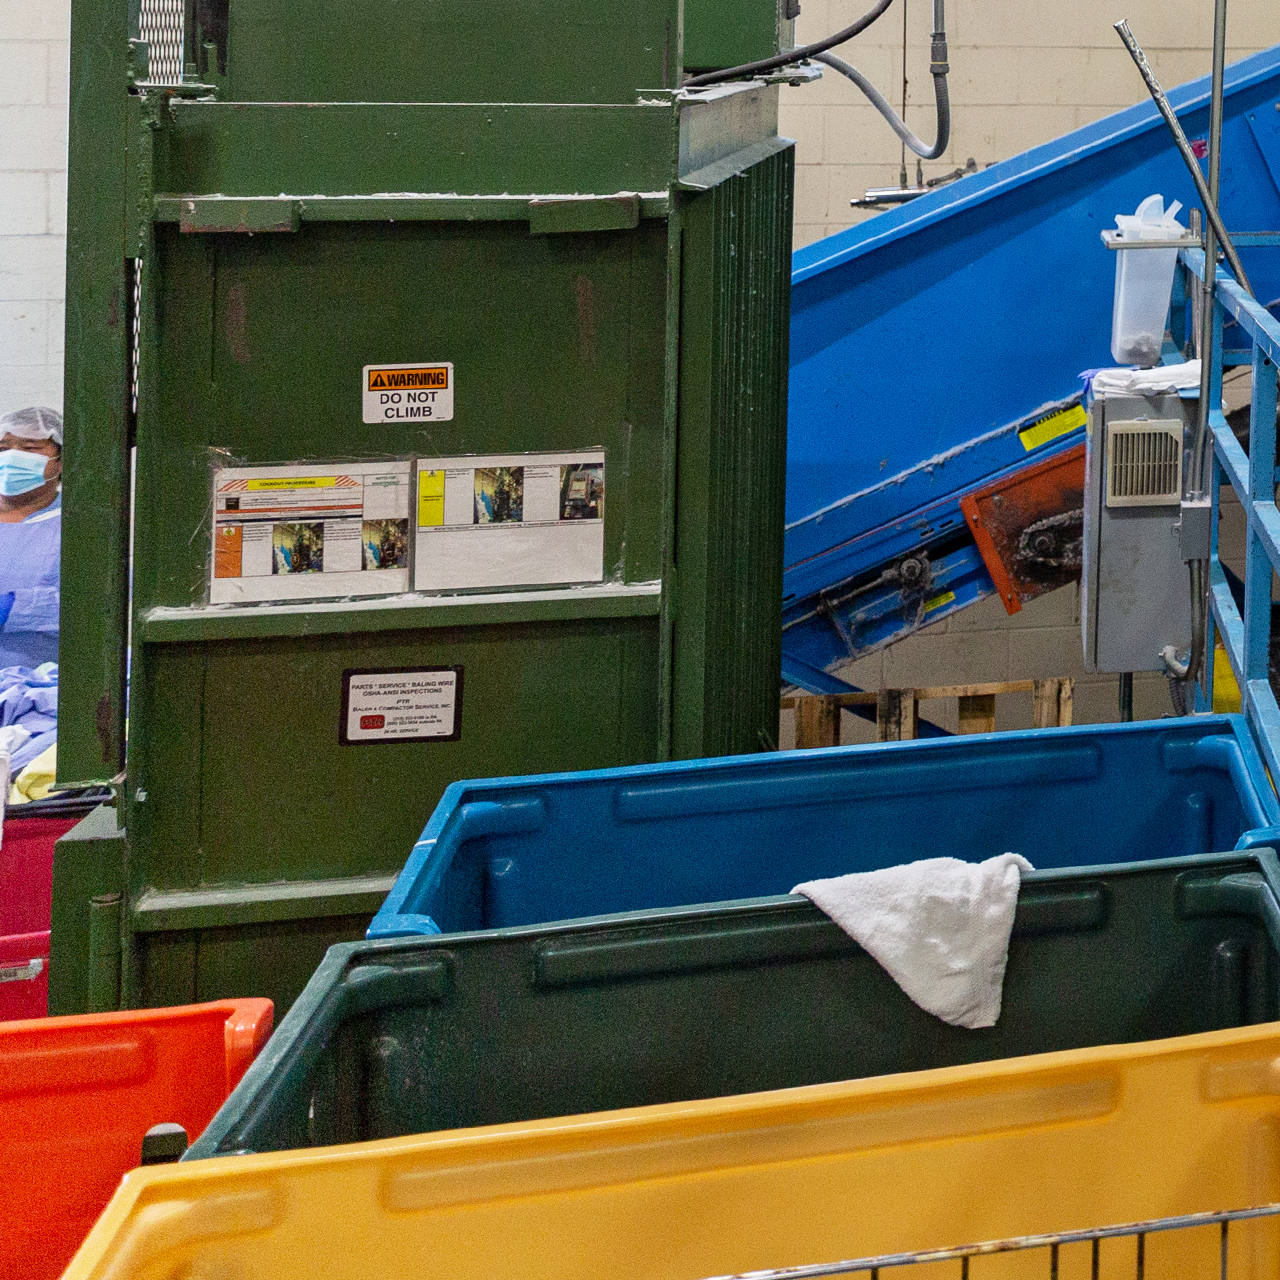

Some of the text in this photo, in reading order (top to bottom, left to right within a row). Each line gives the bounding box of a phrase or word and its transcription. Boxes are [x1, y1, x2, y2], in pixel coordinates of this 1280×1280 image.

[387, 372, 445, 387] WARNING
[380, 391, 438, 405] DO NOT
[384, 406, 433, 419] CLIMB
